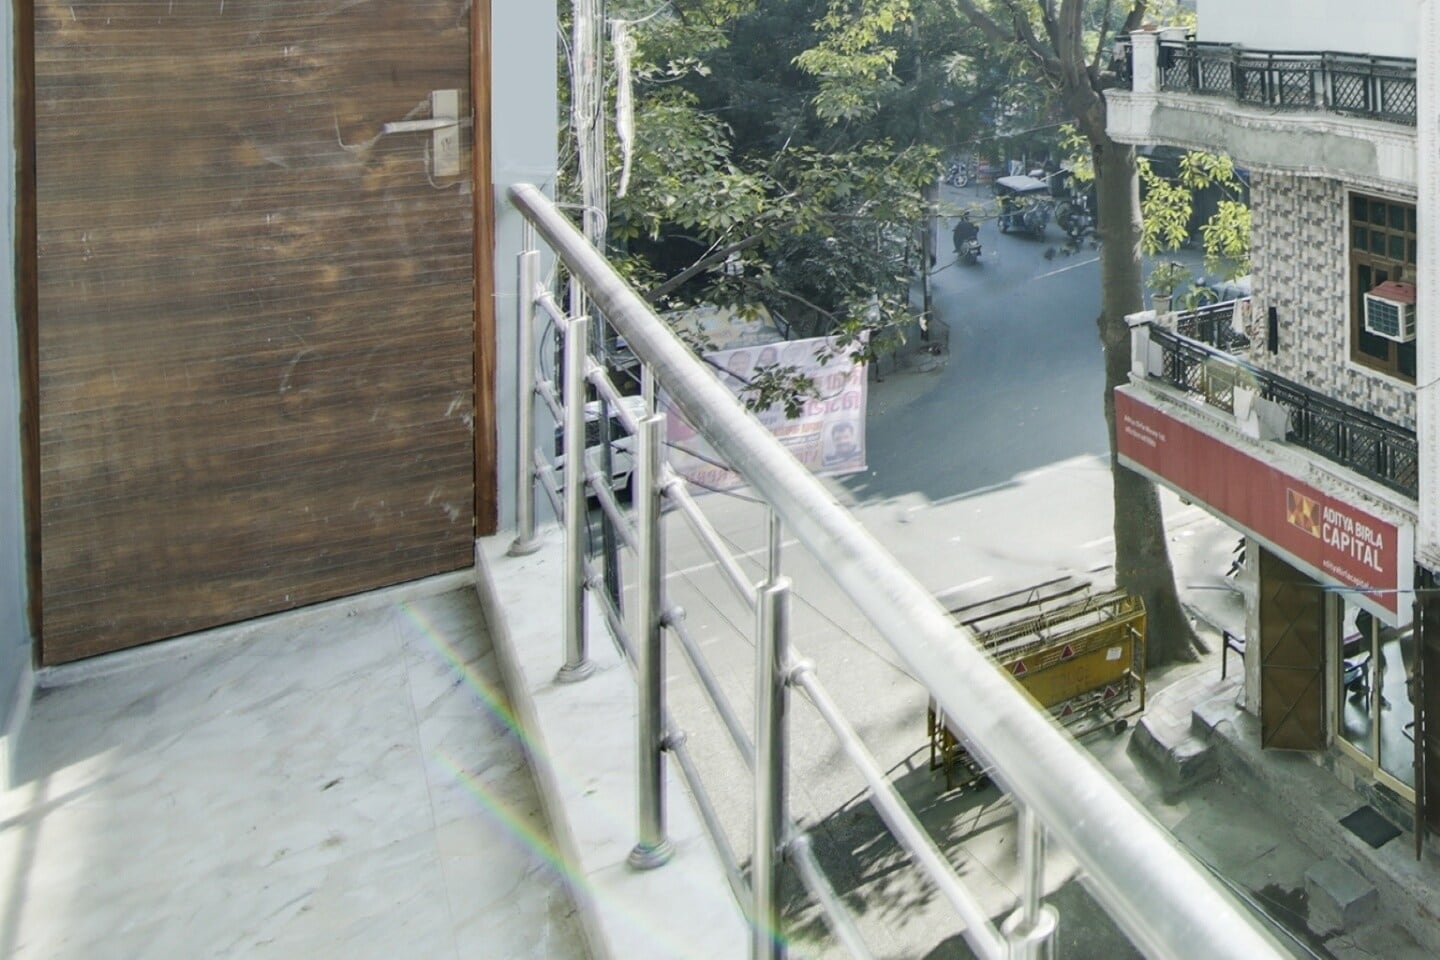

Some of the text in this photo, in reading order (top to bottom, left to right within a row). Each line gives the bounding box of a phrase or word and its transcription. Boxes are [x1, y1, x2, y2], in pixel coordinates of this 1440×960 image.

[1323, 506, 1384, 550] ADITYA BIRLA
[1323, 522, 1383, 573] CAPITAL
